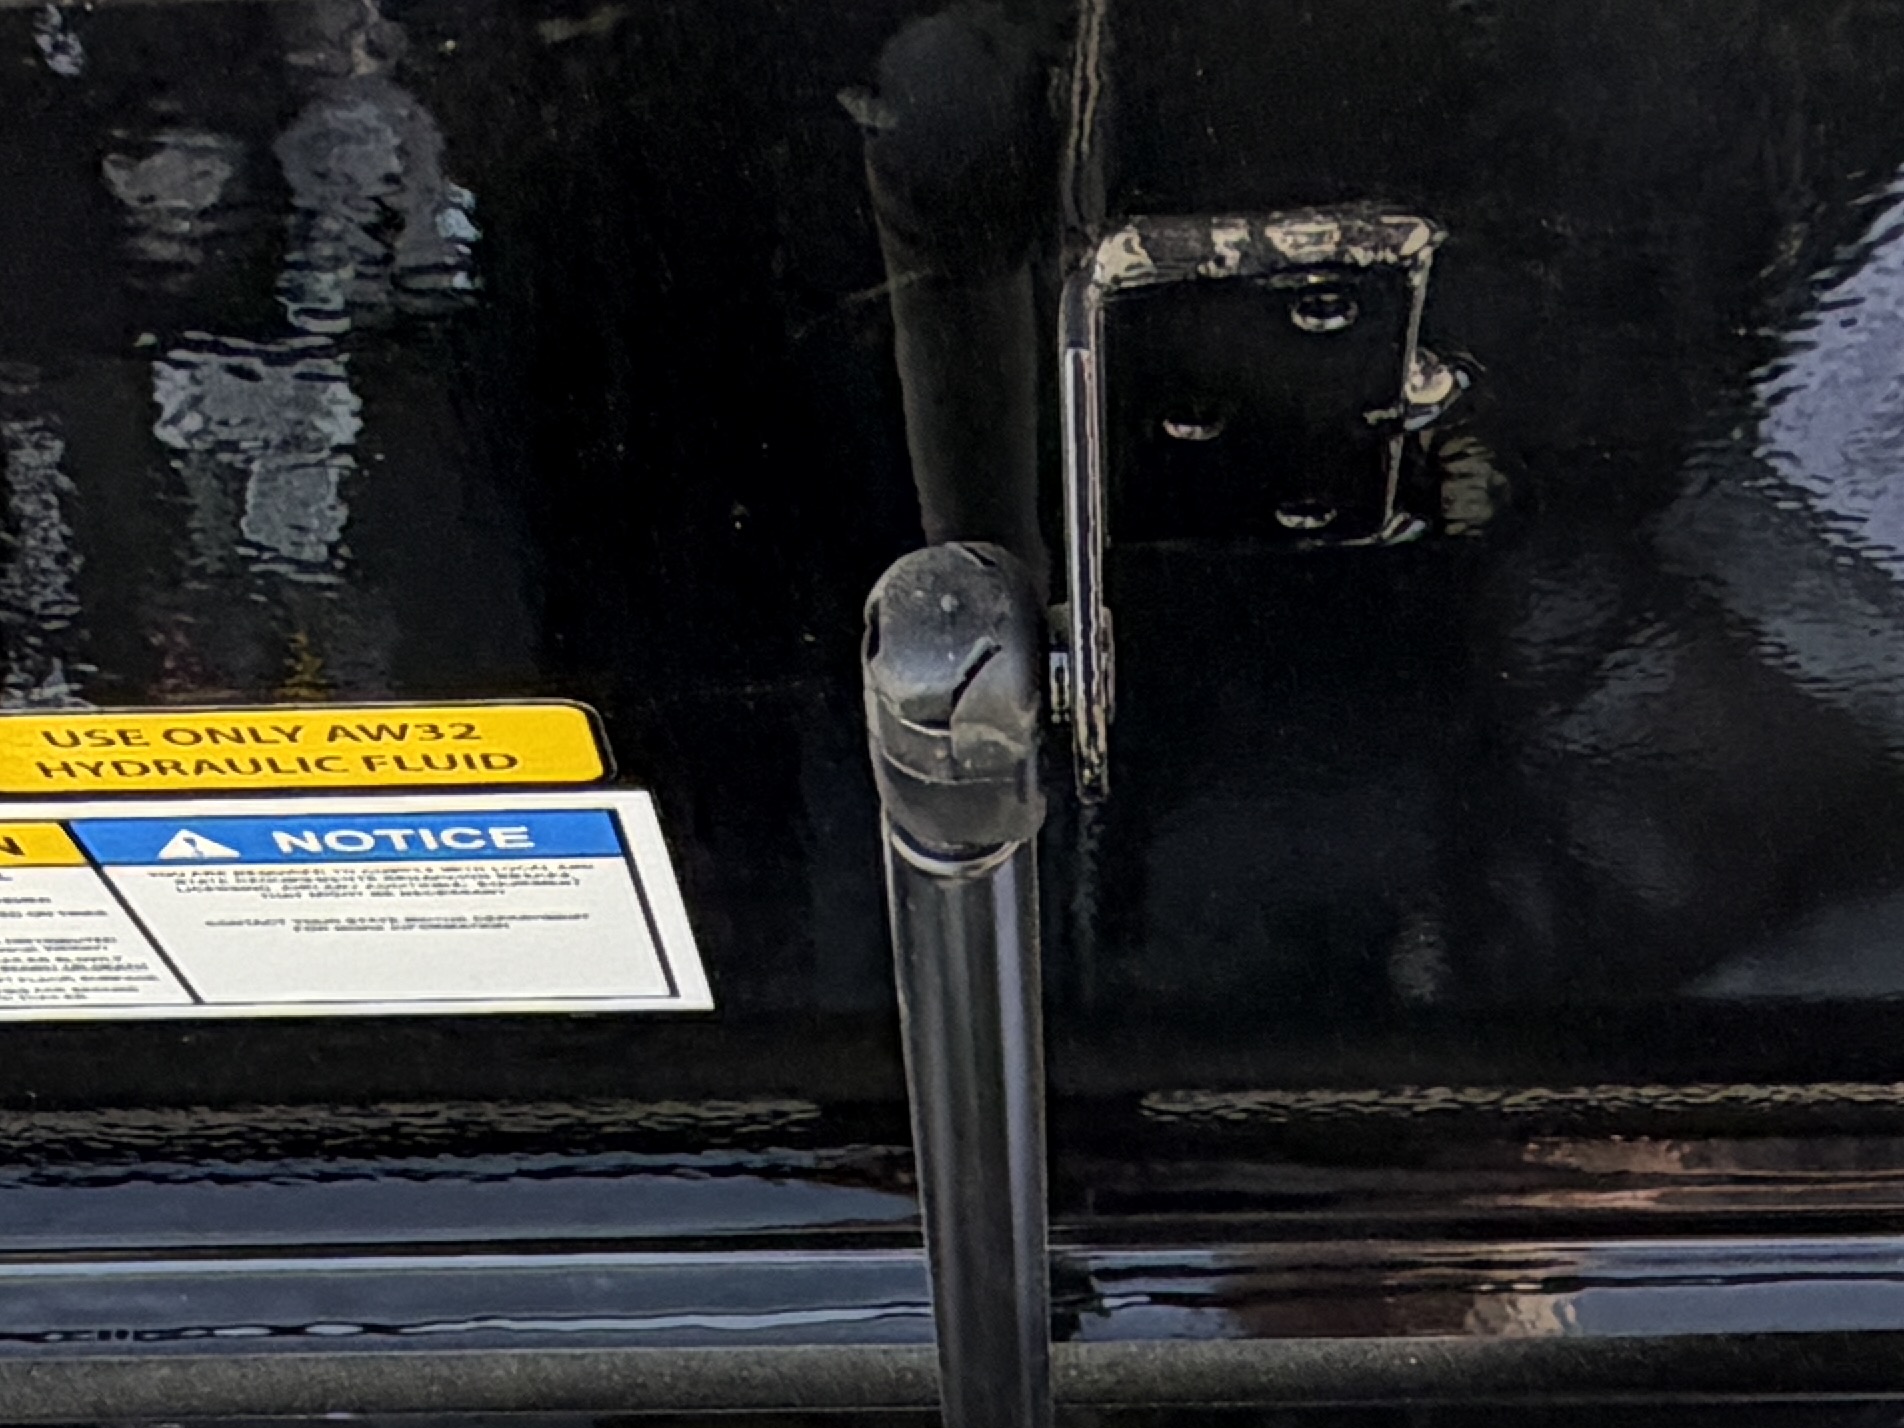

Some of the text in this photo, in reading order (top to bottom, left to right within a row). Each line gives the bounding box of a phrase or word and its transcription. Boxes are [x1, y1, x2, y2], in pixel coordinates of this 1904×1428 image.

[40, 722, 483, 749] USE ONLY AW32
[36, 752, 520, 781] HYDRAULIC FLUID
[271, 826, 536, 853] NOTICE
